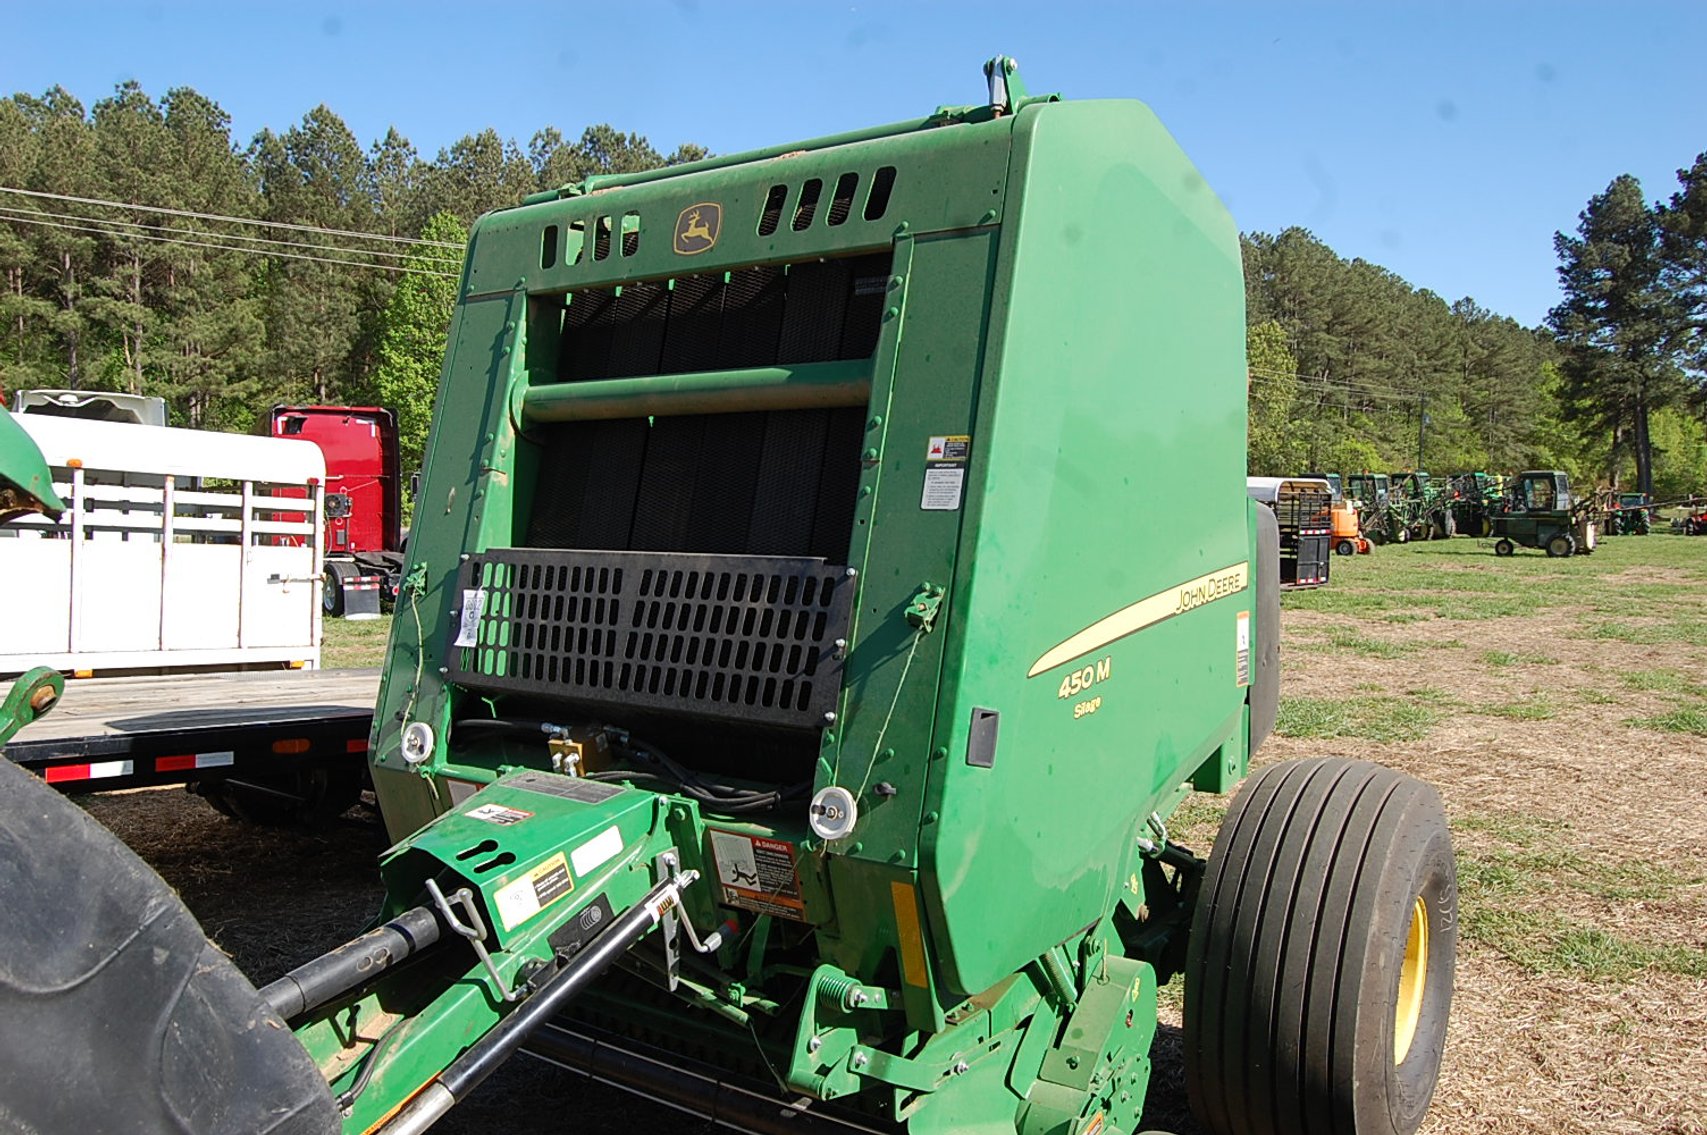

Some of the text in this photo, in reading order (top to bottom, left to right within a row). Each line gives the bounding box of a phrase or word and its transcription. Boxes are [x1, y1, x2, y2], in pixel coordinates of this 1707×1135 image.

[1176, 573, 1241, 611] JOHN DEERE
[1058, 664, 1095, 700] 450
[1074, 696, 1102, 719] Silage
